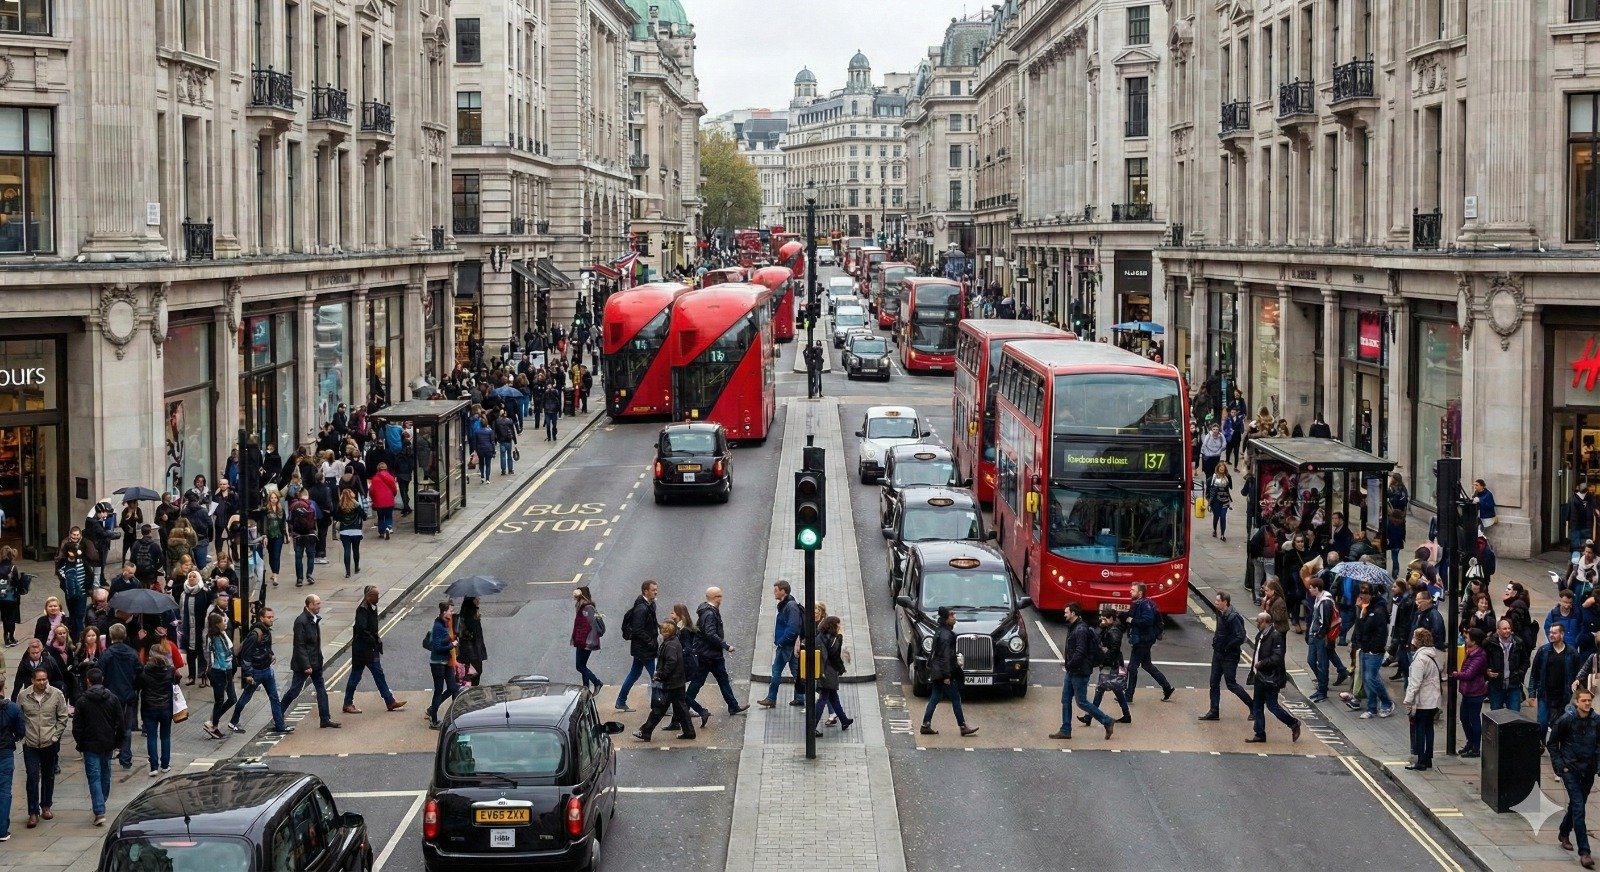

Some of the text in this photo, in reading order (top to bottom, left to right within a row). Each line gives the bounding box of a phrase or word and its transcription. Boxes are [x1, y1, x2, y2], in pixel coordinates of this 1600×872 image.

[0, 367, 46, 387] ours
[1144, 452, 1166, 469] 137
[522, 502, 606, 516] BUS
[496, 518, 609, 533] STOP
[480, 811, 525, 820] EV65 ZXX
